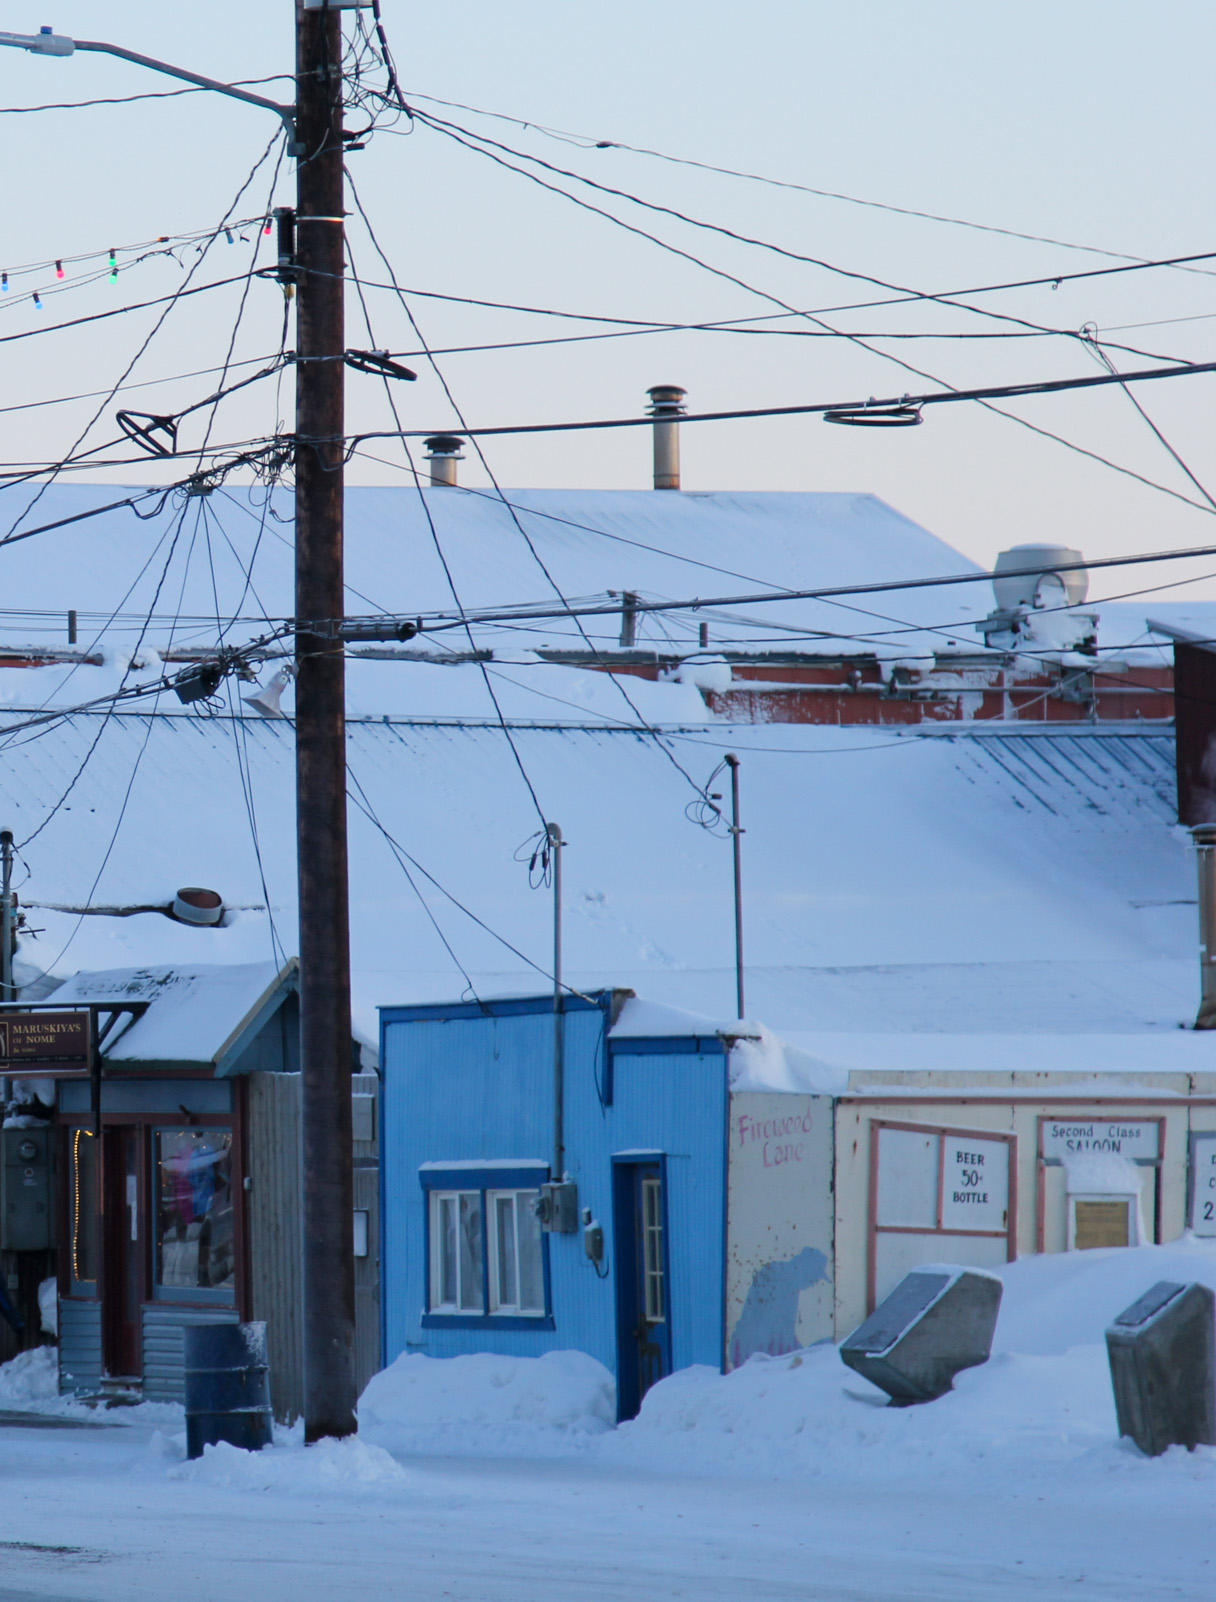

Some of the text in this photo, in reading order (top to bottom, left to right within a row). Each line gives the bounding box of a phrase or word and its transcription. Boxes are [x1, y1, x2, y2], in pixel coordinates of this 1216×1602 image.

[13, 1024, 81, 1034] MARUSKIYA'S
[26, 1035, 56, 1044] NOME
[738, 1104, 813, 1147] Fireweed
[1052, 1124, 1141, 1138] Second Class
[763, 1141, 804, 1168] Lane
[957, 1151, 984, 1165] BEER
[953, 1191, 988, 1203] BOTTLE
